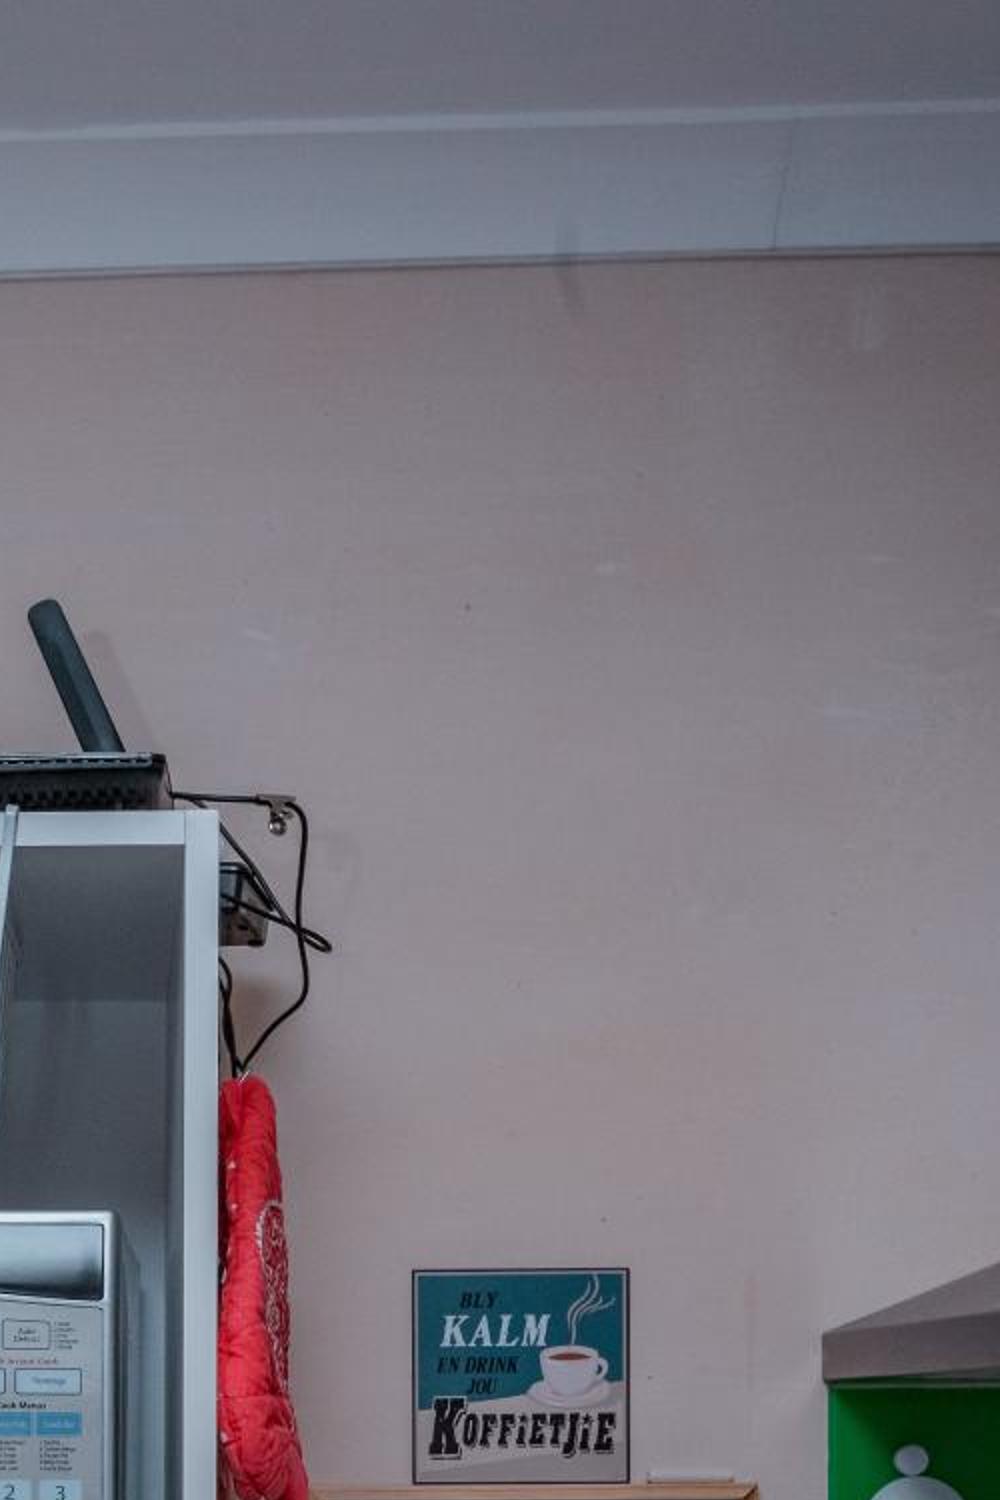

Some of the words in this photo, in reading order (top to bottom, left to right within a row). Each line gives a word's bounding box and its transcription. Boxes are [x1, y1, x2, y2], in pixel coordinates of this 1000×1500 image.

[460, 1291, 499, 1309] BLY
[440, 1313, 551, 1348] KALM
[436, 1356, 463, 1375] EN
[464, 1355, 520, 1375] DRINK
[469, 1377, 498, 1395] JOU
[3, 1484, 16, 1500] 2
